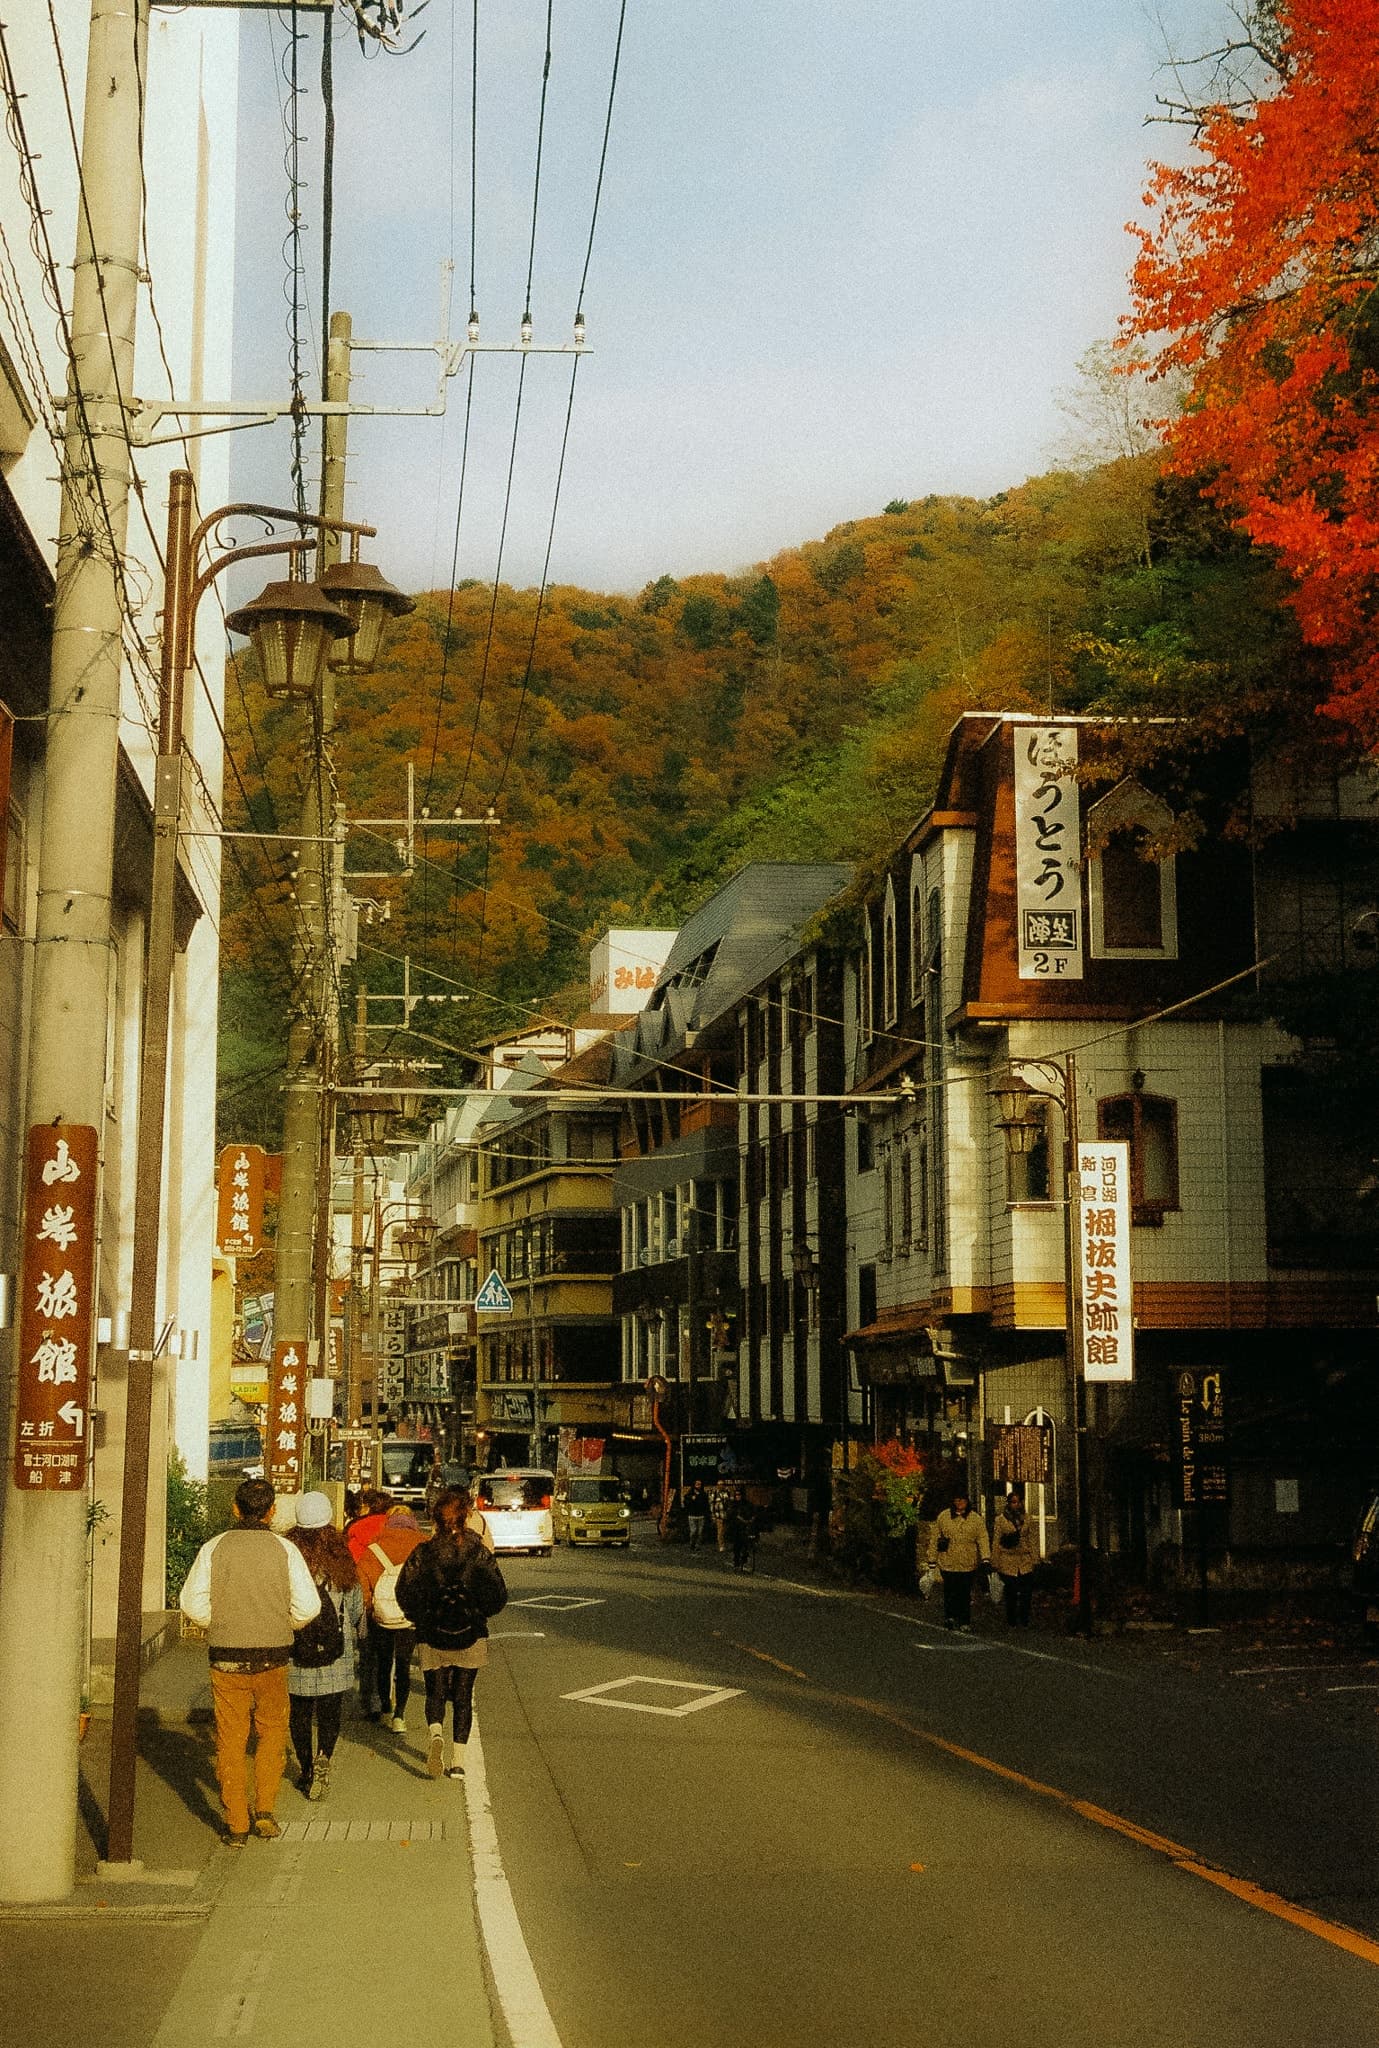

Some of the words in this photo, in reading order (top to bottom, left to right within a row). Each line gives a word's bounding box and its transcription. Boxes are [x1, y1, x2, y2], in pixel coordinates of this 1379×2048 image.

[1027, 731, 1066, 901] ほうとう
[614, 966, 659, 990] みは
[1033, 952, 1068, 974] 2F
[230, 1151, 251, 1232] 山岸旅館
[1101, 1156, 1118, 1202] 河口湖
[30, 1138, 81, 1386] 山岸旅館
[276, 1346, 300, 1451] 山岸旅館
[20, 1421, 55, 1437] 左折
[23, 1454, 79, 1468] 富士河口湖町
[28, 1471, 73, 1485] 船津
